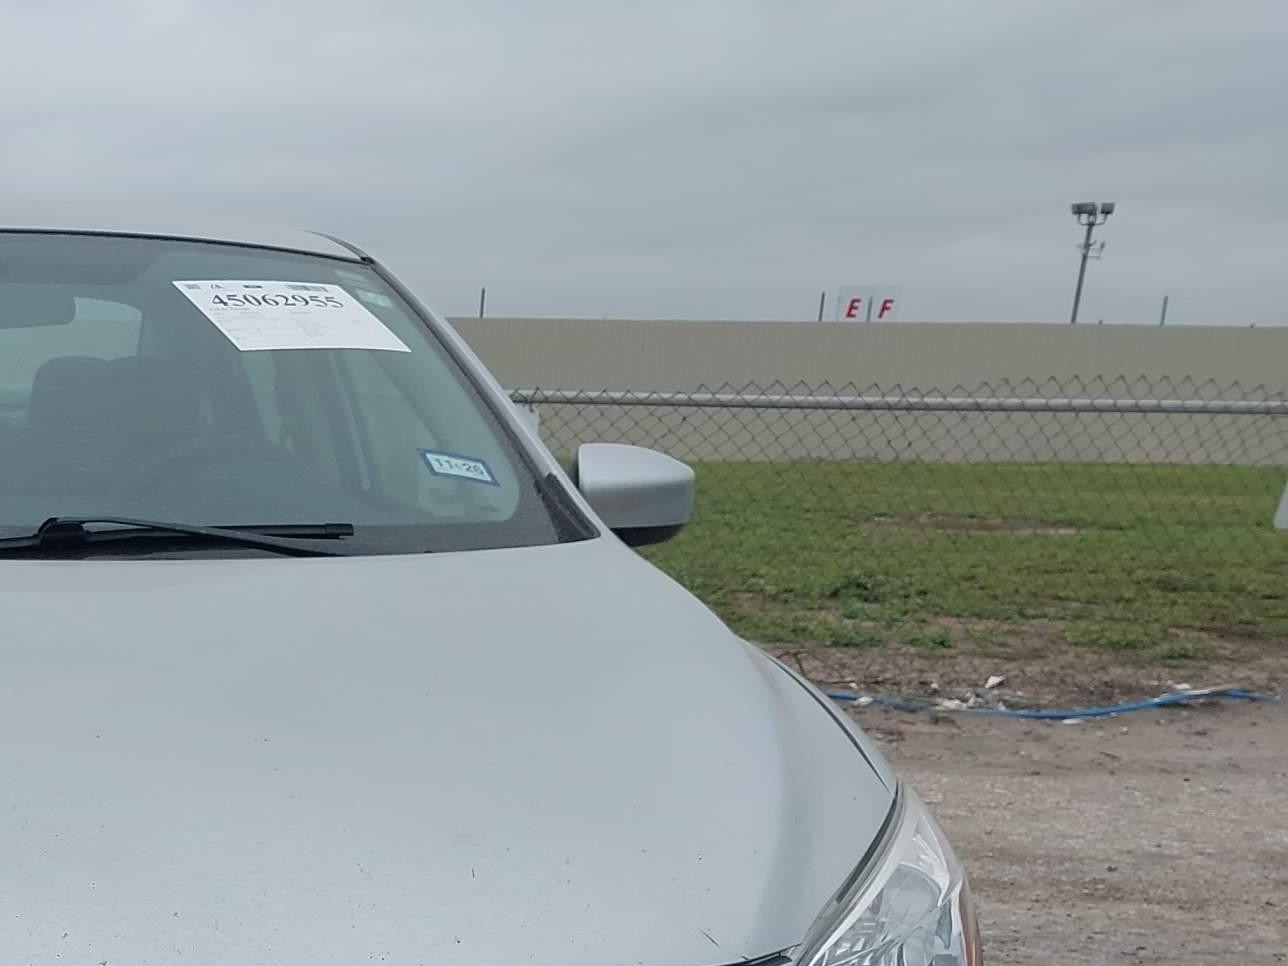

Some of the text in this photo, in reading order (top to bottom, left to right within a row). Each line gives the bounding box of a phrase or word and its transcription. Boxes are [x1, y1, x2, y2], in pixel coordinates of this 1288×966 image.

[211, 293, 345, 309] 45062955
[846, 299, 861, 318] E
[878, 299, 894, 319] F
